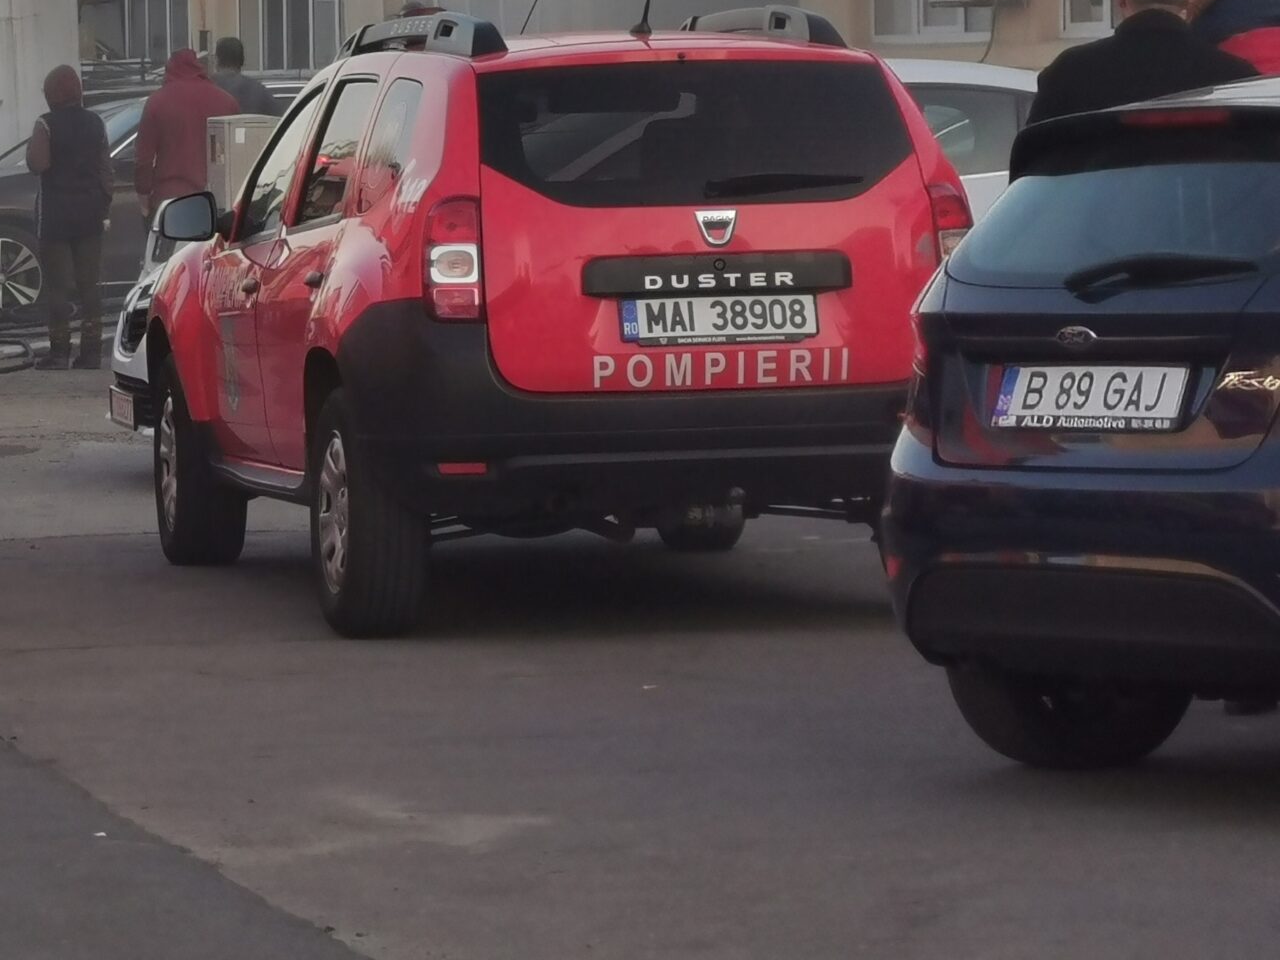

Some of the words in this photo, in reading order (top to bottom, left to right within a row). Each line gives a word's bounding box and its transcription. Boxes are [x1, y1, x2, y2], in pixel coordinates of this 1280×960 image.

[644, 271, 795, 290] DUSTER
[624, 323, 638, 335] RO
[645, 300, 695, 334] MAI
[710, 297, 808, 331] 38908
[593, 347, 849, 389] POMPIERII
[1021, 371, 1048, 410] B
[1055, 371, 1094, 410] 89
[1103, 371, 1168, 412] GAJ
[1021, 416, 1054, 427] ALD
[1057, 417, 1126, 429] Automotive
